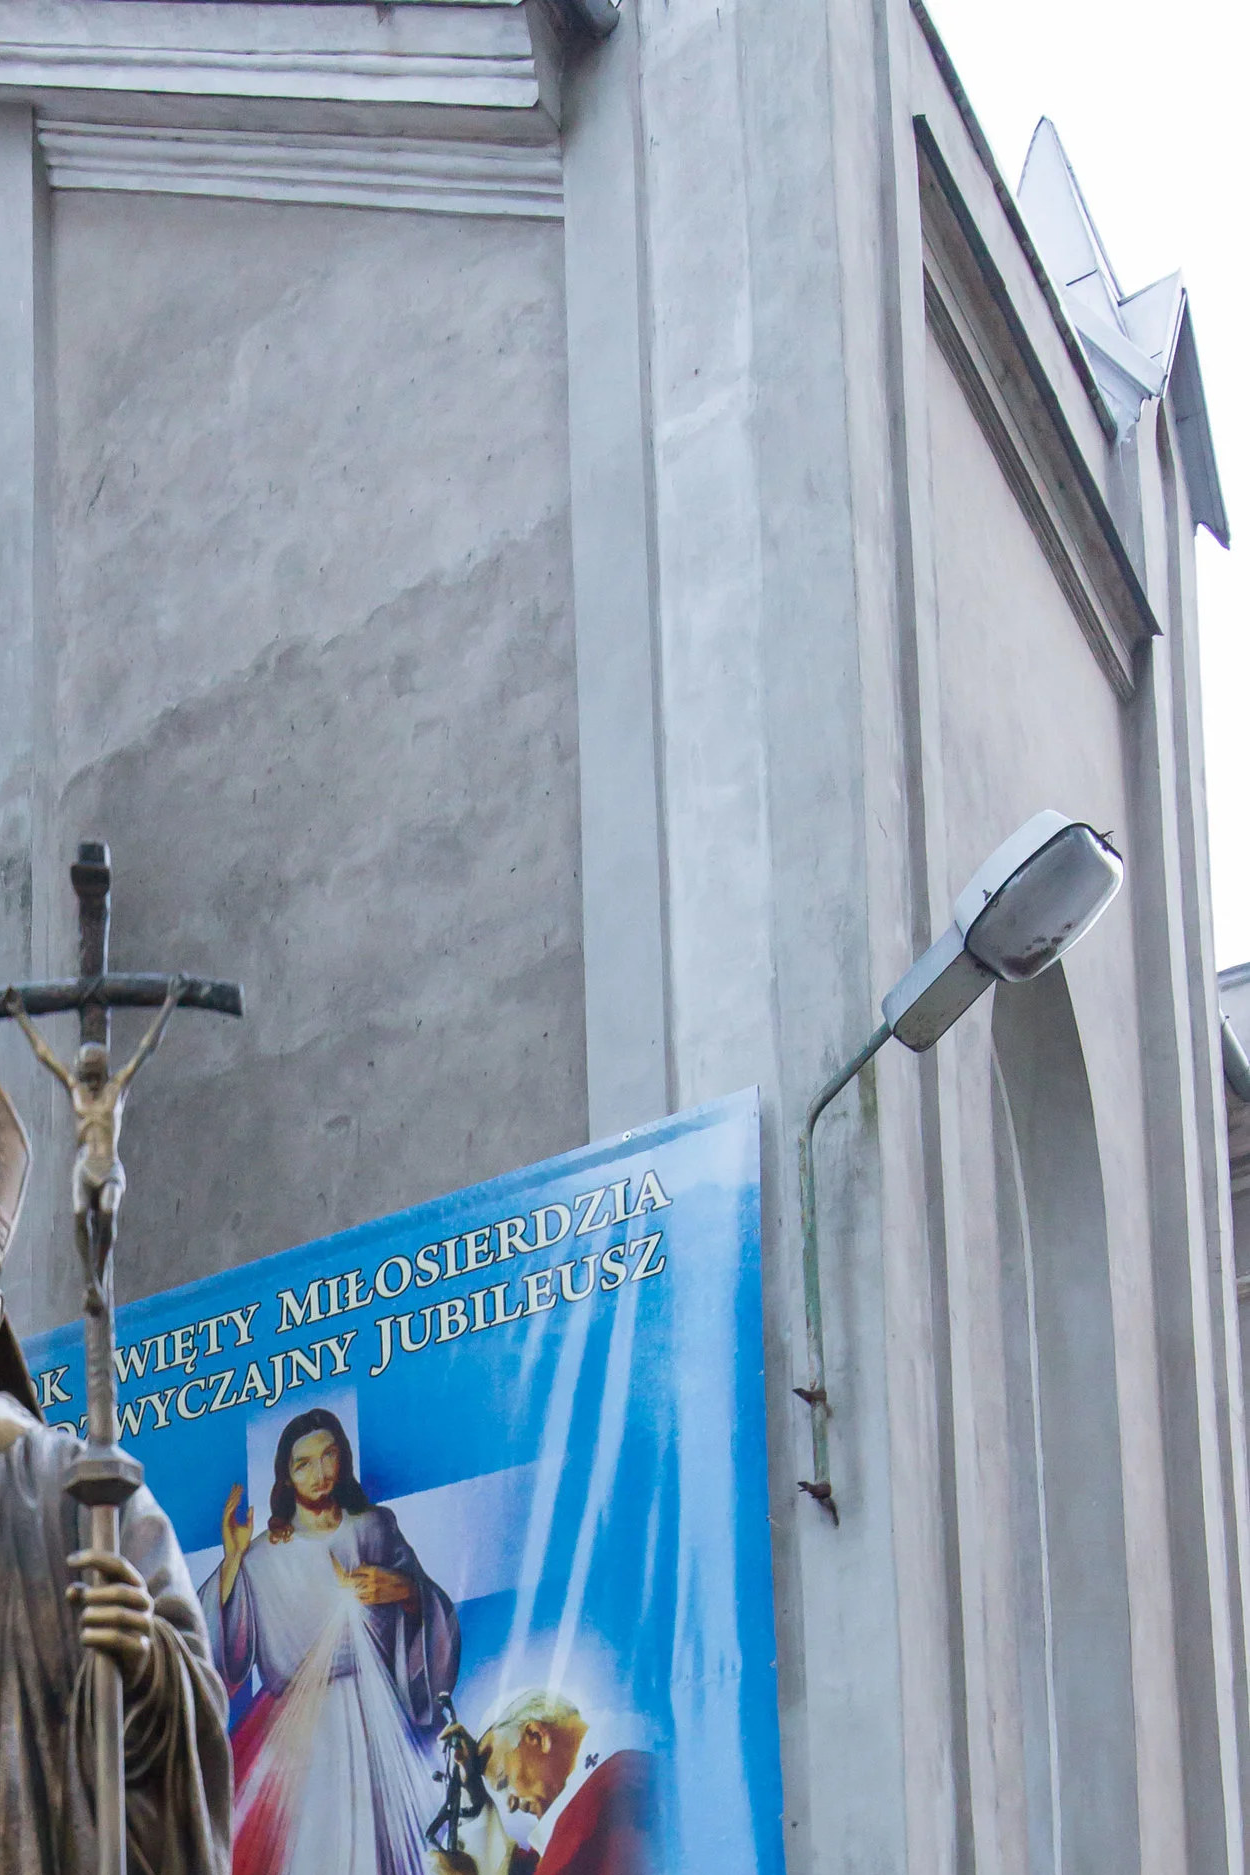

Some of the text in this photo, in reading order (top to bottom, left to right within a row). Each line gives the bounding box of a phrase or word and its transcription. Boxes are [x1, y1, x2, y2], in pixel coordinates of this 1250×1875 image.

[111, 1301, 262, 1385] WIĘTY
[276, 1168, 674, 1335] MIŁOSIERDZIA
[369, 1230, 669, 1378] JUBILEUSZ
